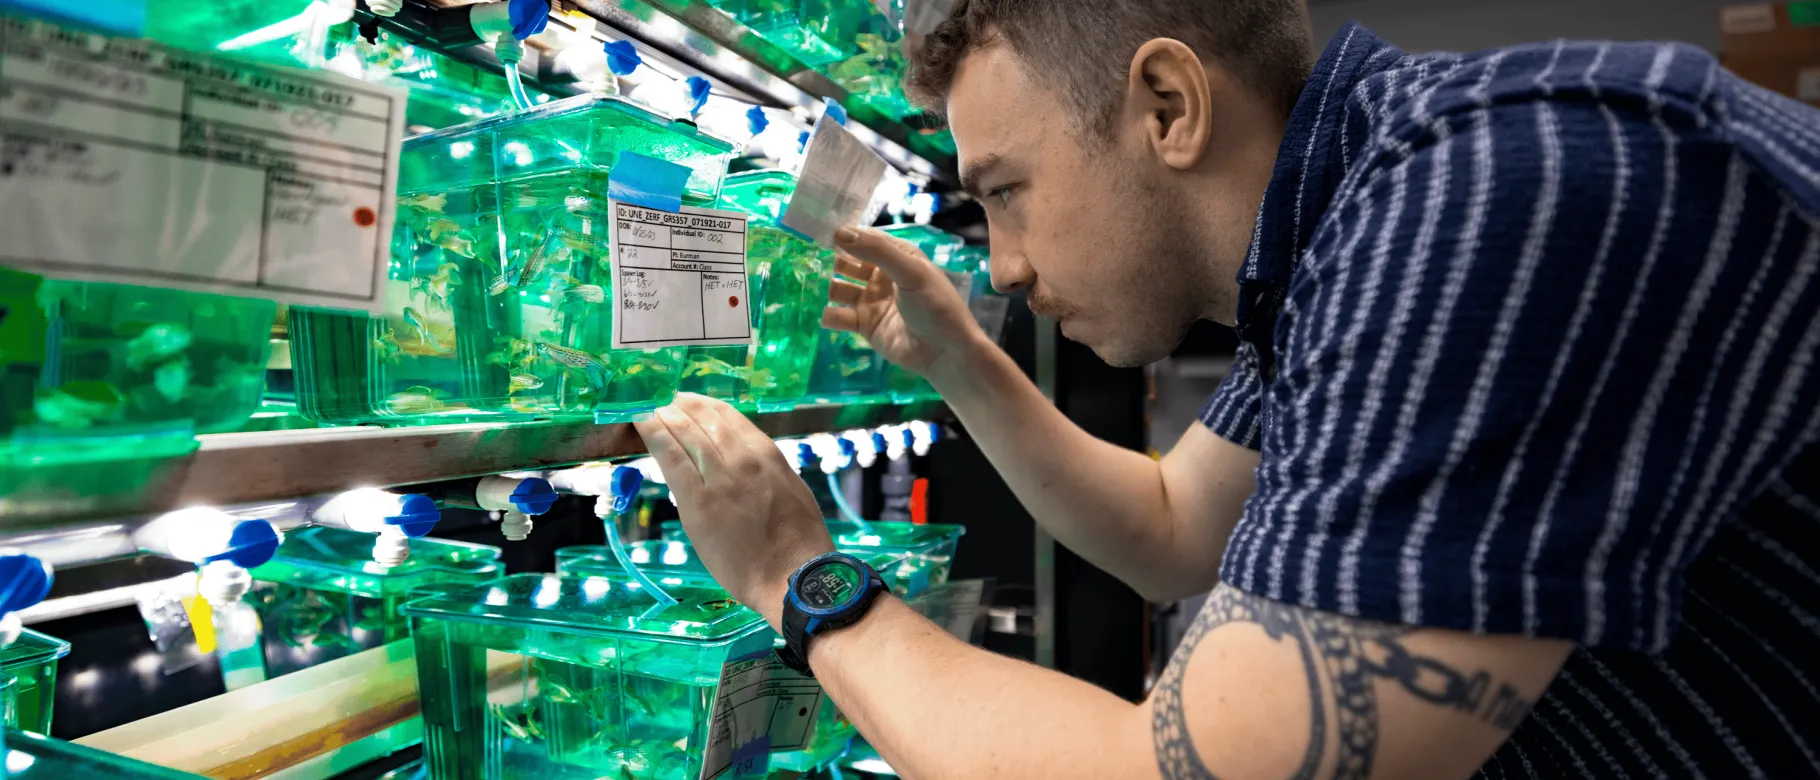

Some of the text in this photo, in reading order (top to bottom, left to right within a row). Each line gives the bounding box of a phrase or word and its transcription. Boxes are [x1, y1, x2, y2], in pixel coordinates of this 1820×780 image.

[618, 208, 627, 217] ID:
[619, 222, 631, 230] DOB:
[672, 229, 697, 238] Individual
[680, 252, 699, 260] Burman
[673, 262, 693, 270] Account
